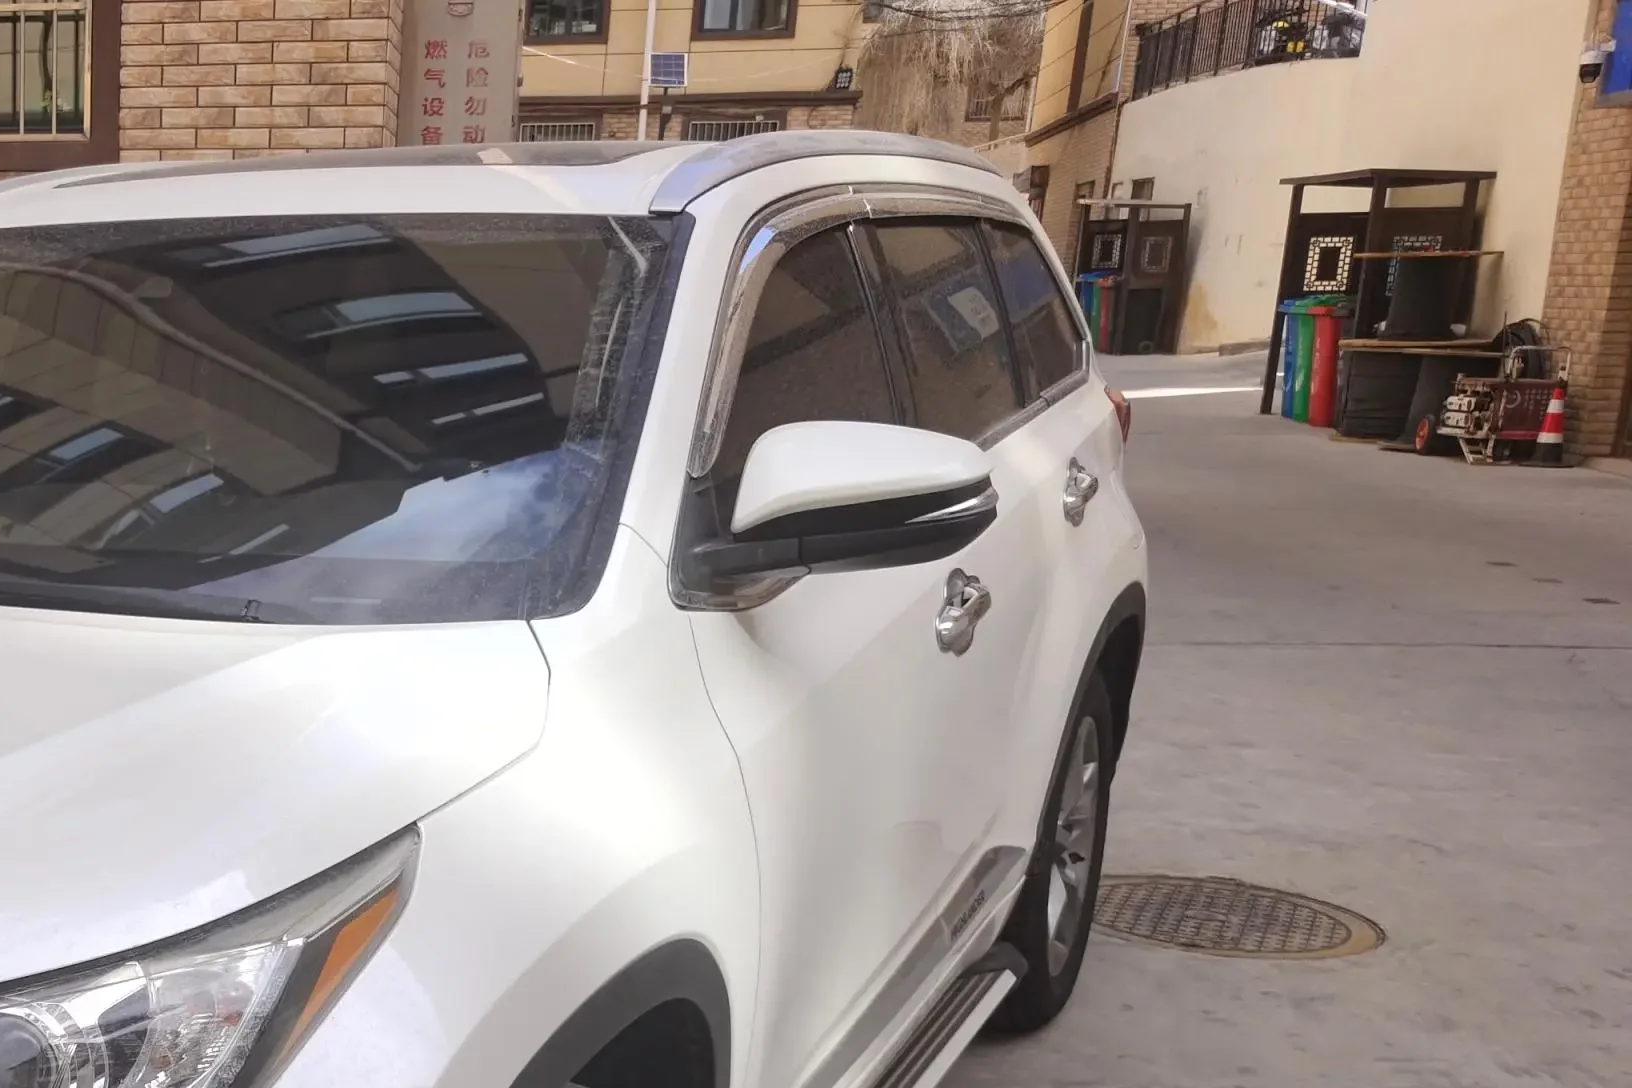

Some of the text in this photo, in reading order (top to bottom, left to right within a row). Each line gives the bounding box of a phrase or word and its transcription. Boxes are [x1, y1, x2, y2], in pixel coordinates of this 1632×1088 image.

[421, 39, 448, 146] 燃气设备
[462, 40, 490, 144] 危险勿动
